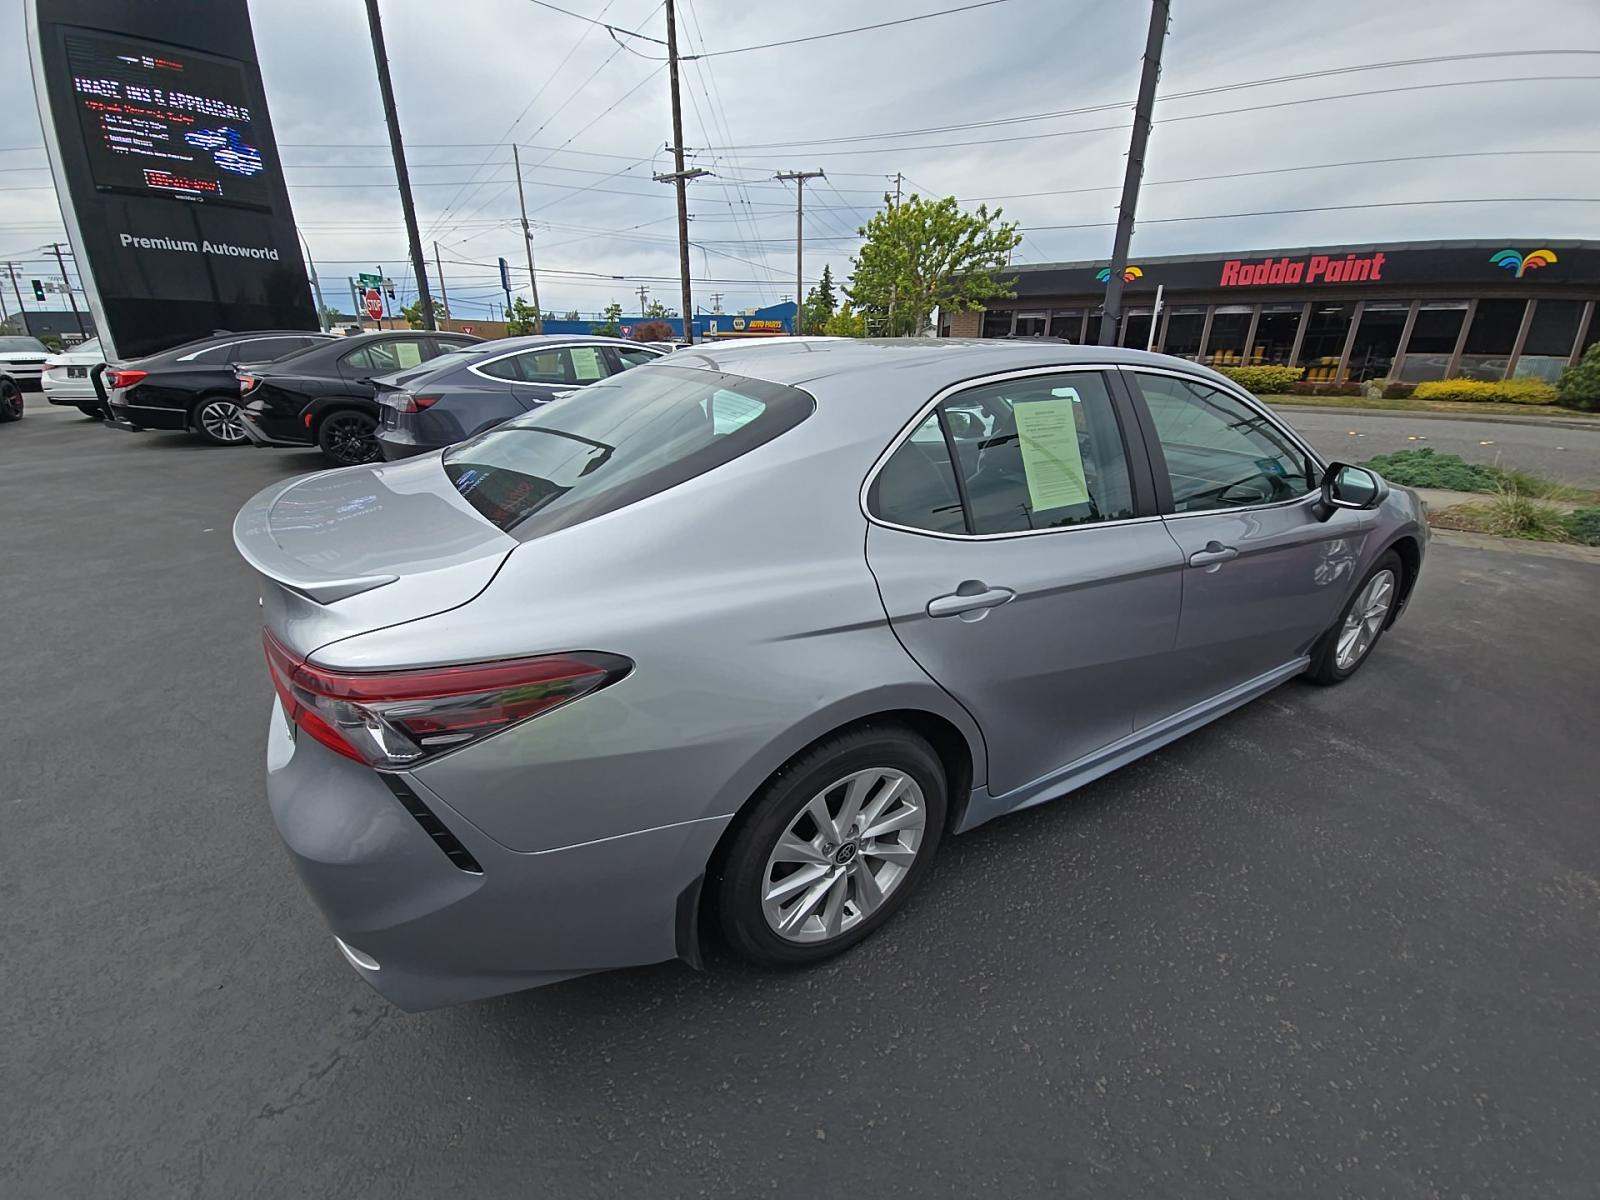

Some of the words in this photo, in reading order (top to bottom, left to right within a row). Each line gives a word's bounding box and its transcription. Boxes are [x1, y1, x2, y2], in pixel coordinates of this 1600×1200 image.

[119, 233, 198, 252] Premium
[202, 240, 279, 261] Autoworld
[1220, 257, 1304, 287] Rodda
[1305, 252, 1386, 283] Paint
[367, 299, 381, 311] STOP
[749, 320, 764, 328] AUTO
[765, 320, 783, 328] PARTS
